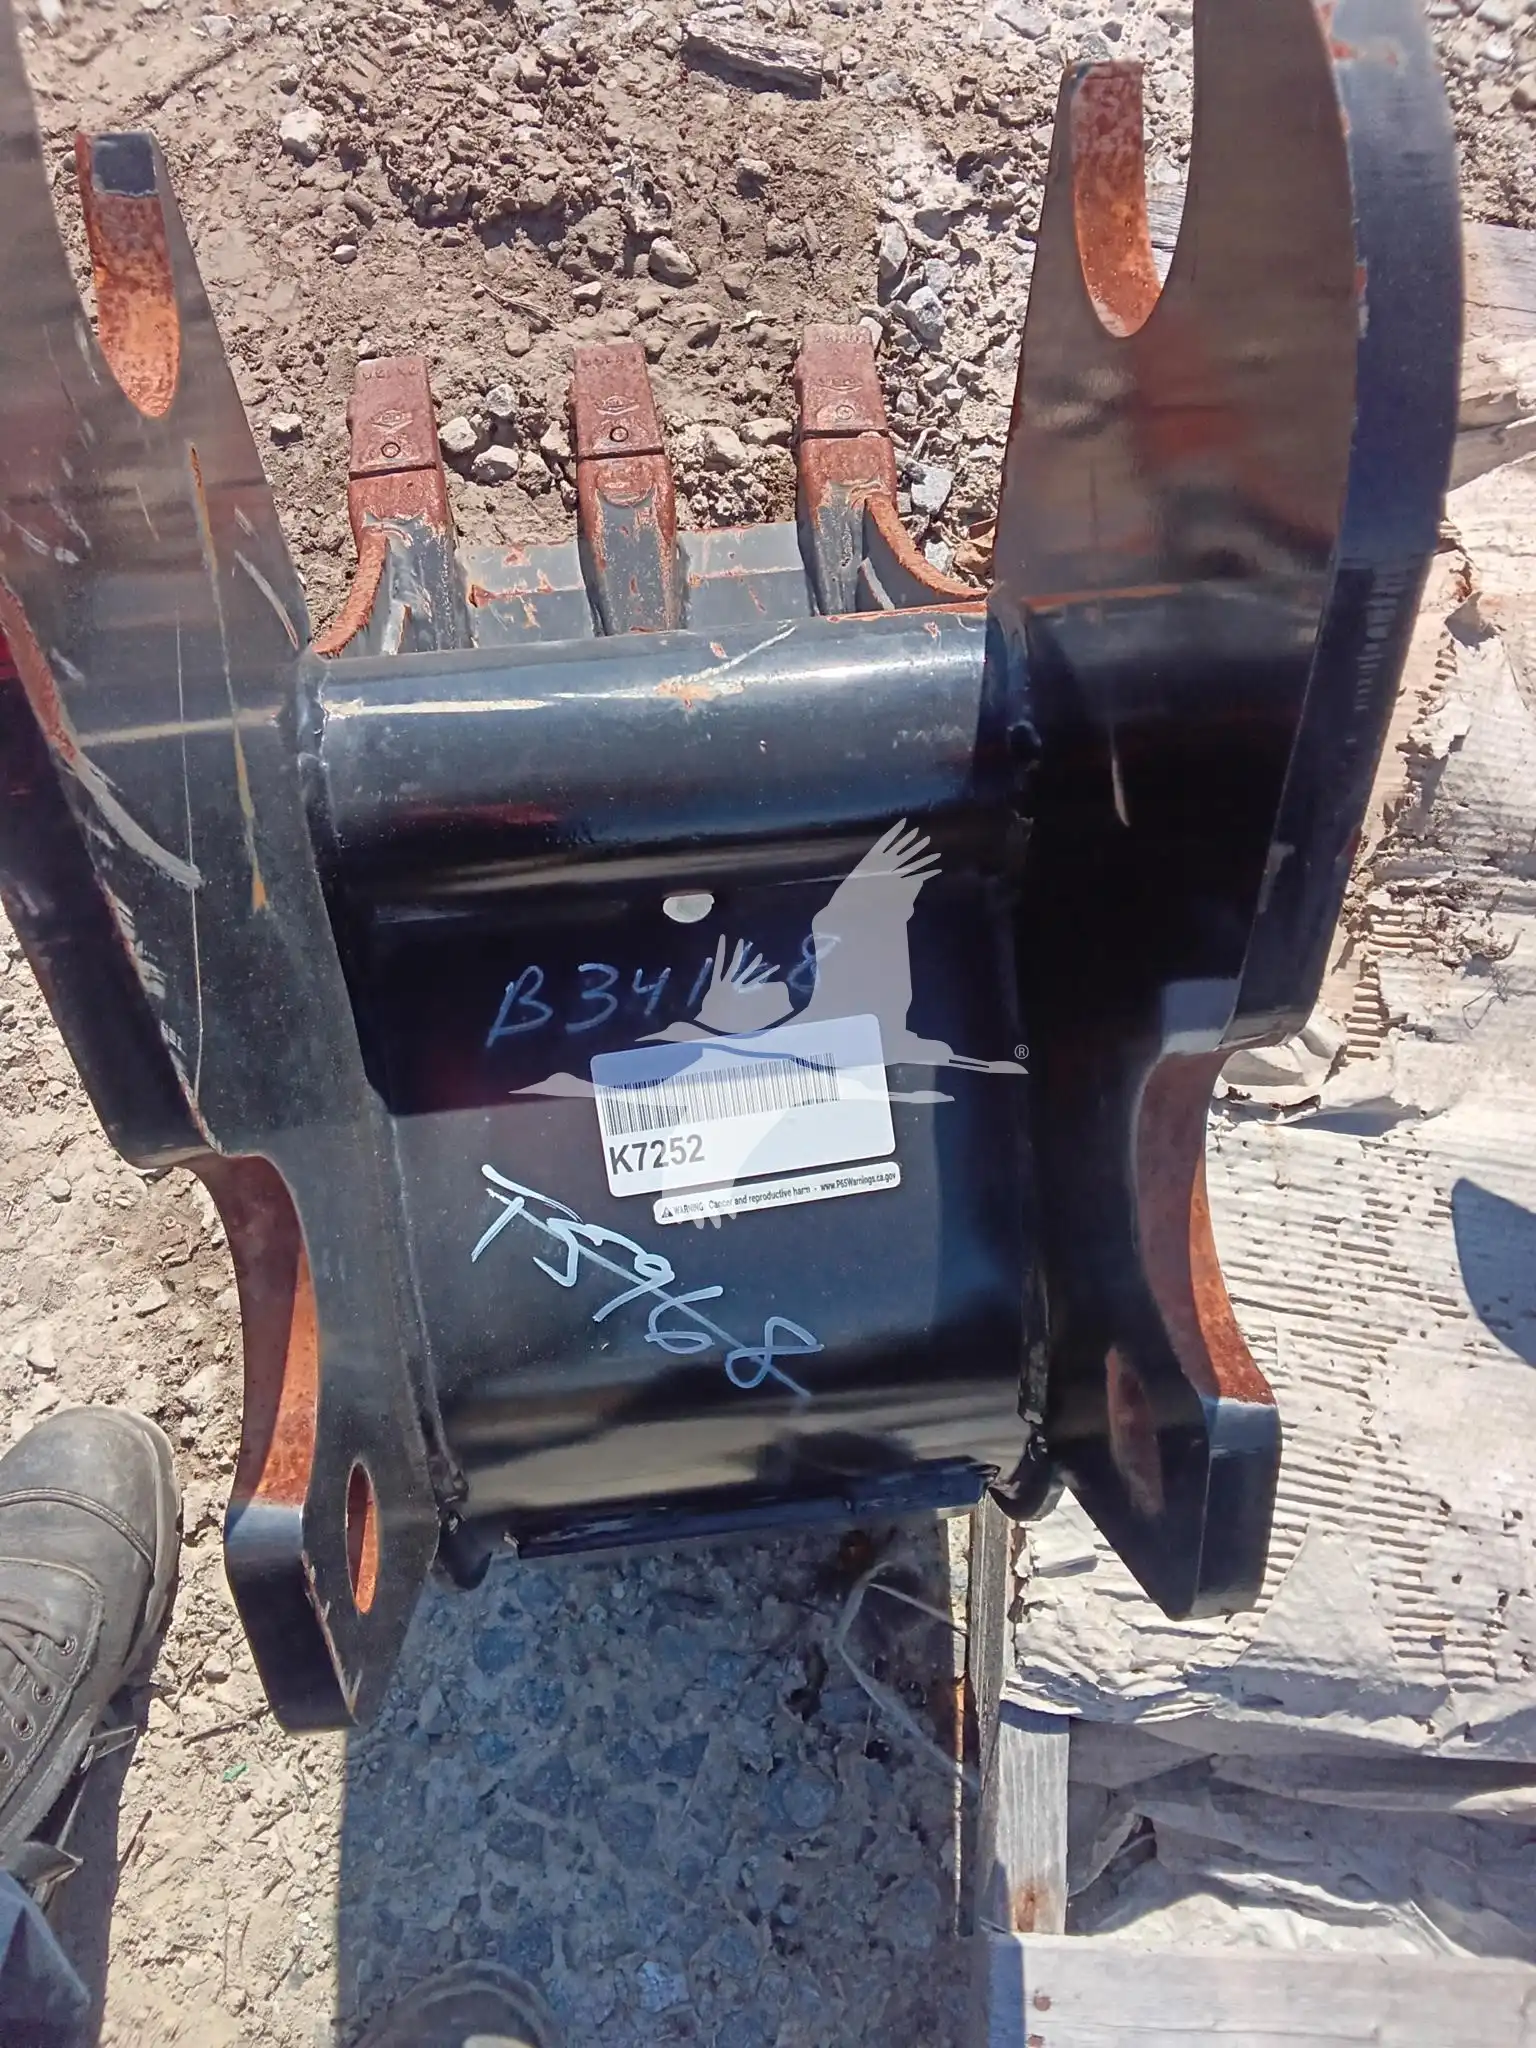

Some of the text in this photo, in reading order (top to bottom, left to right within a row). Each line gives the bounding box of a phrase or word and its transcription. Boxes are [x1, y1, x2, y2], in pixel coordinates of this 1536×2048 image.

[609, 1134, 705, 1175] K7252
[708, 1198, 733, 1209] Cancer
[734, 1195, 747, 1205] and
[748, 1189, 791, 1204] reproductive
[792, 1186, 811, 1196] harm
[820, 1171, 896, 1191] www.P65Warnings.ca.gov
